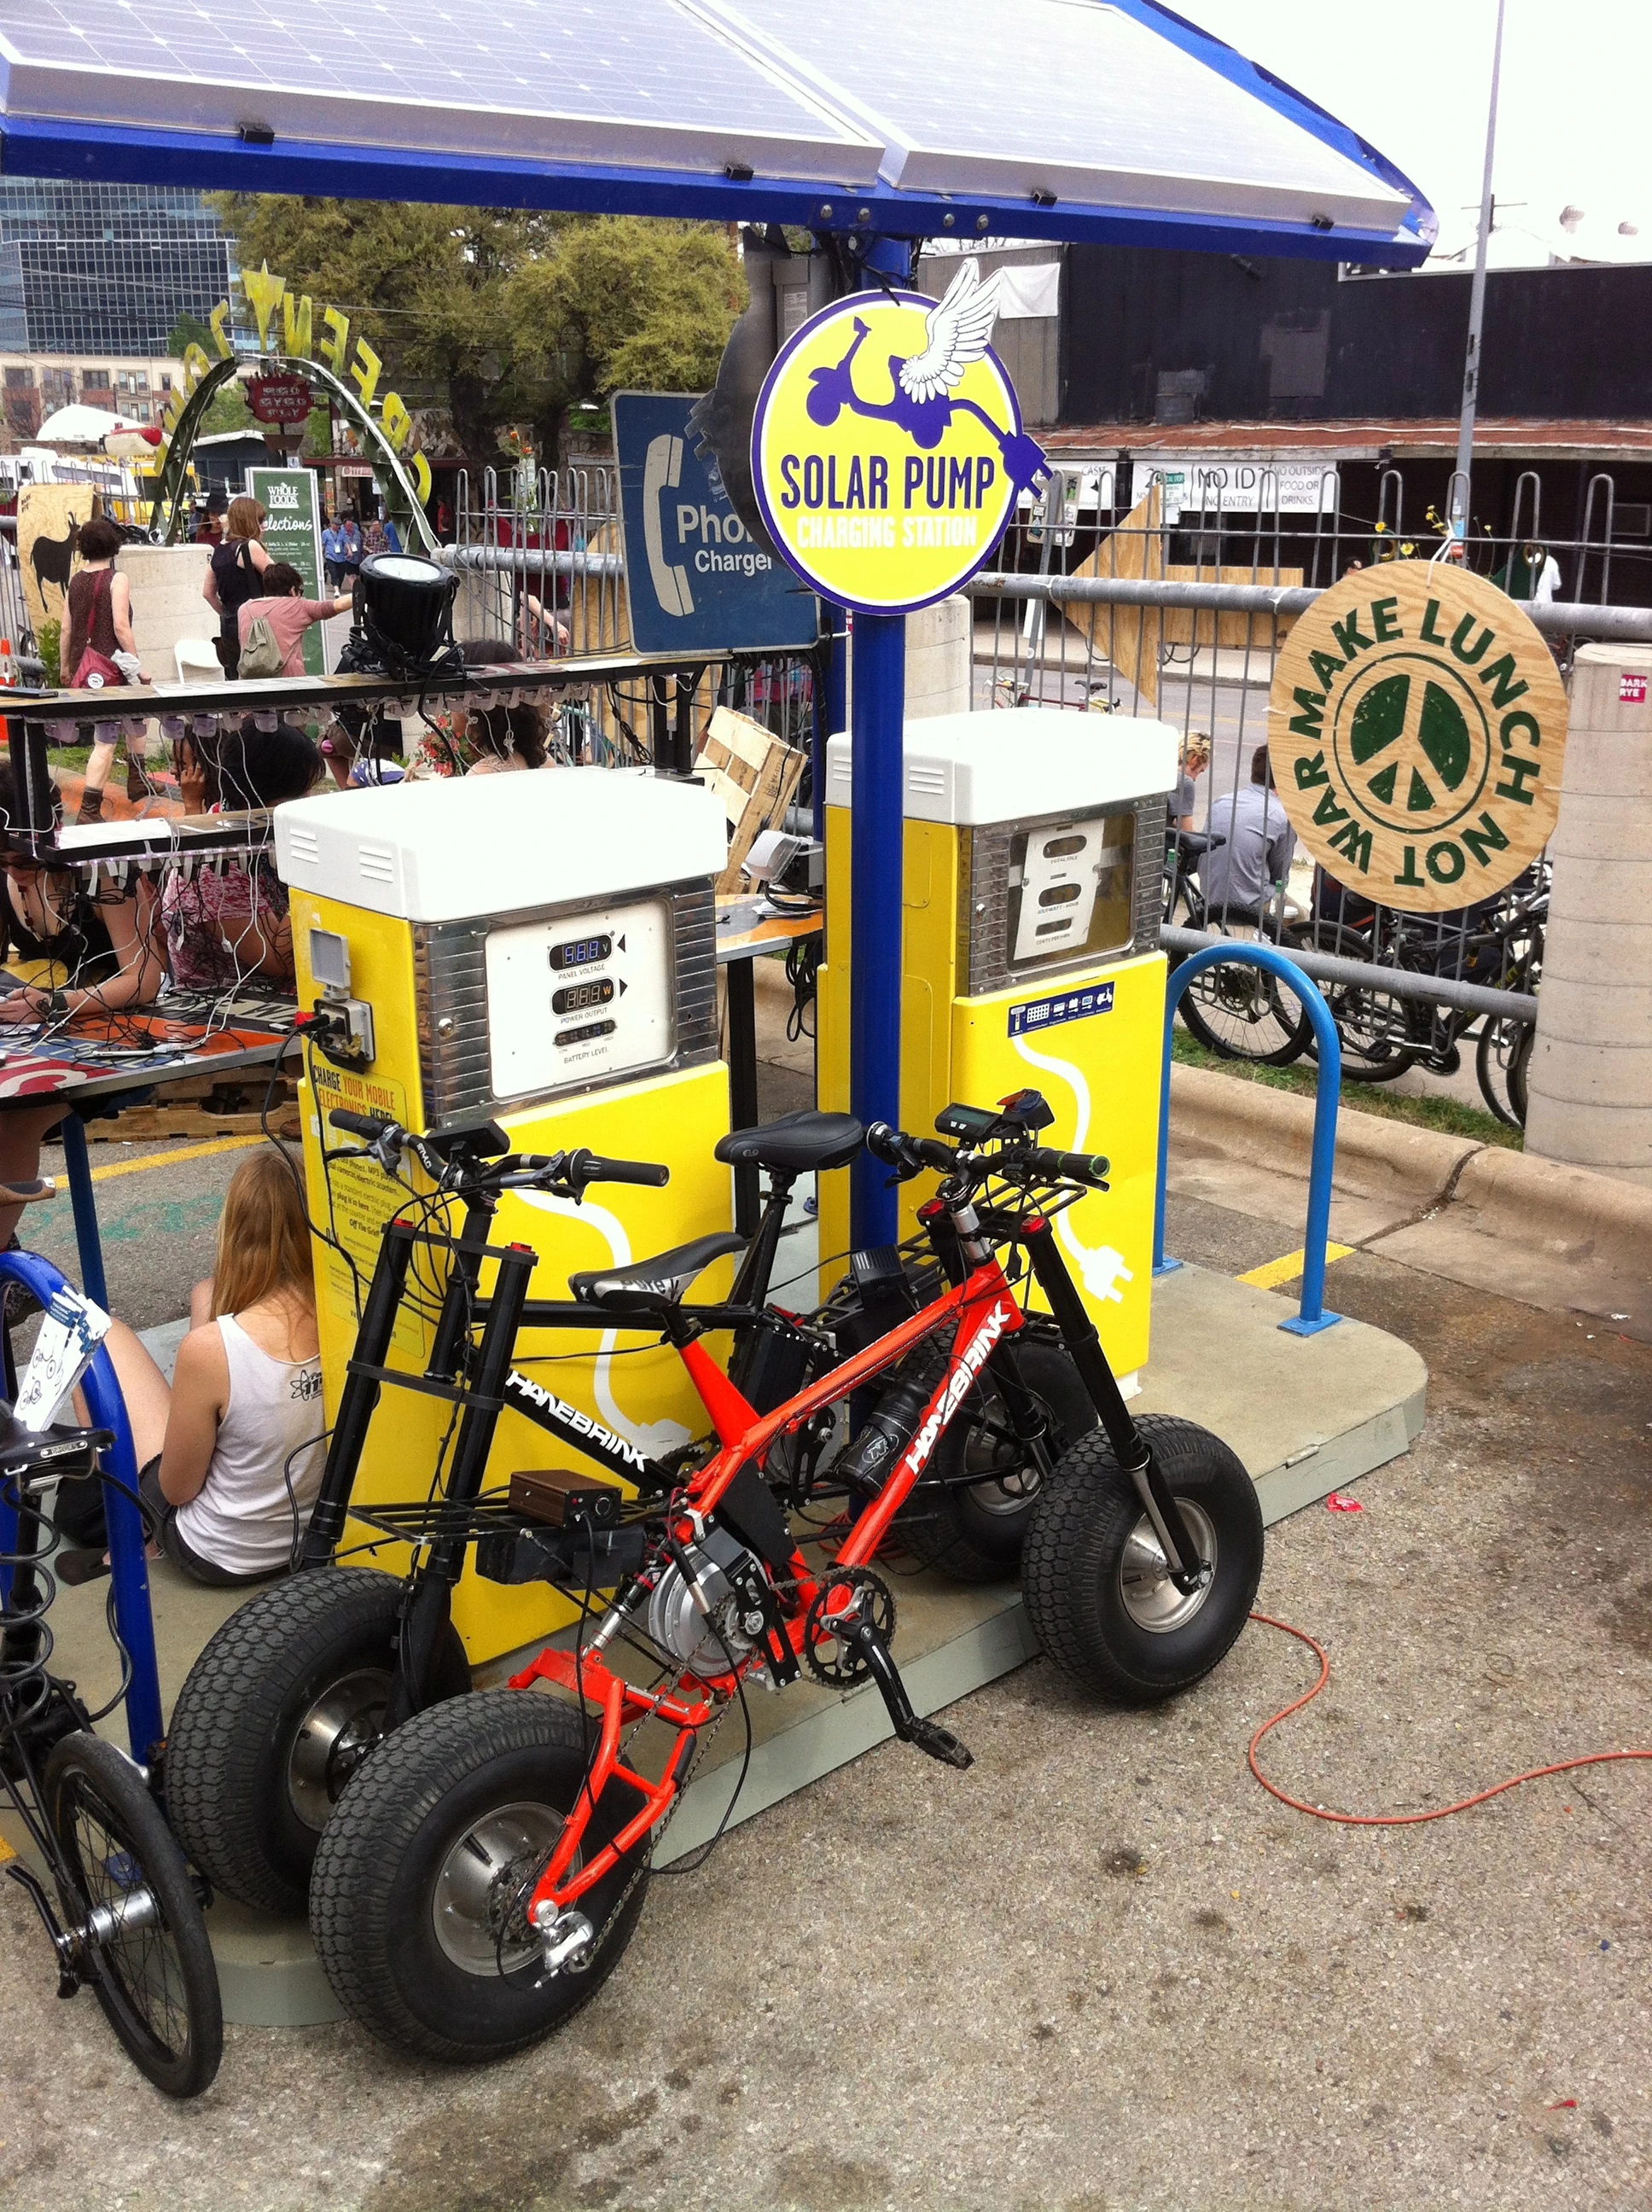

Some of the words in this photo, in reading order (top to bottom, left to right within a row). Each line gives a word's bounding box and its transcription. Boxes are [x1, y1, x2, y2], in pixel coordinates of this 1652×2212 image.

[1197, 468, 1228, 489] NO
[1288, 465, 1328, 476] OUTSIDE
[267, 484, 299, 497] WHOLE
[781, 454, 888, 509] SOLAR
[904, 456, 995, 509] PUMP
[1279, 480, 1305, 491] FOOD
[1306, 480, 1319, 491] OR
[269, 495, 298, 505] FOODS
[1206, 496, 1219, 507] NO
[1223, 496, 1254, 507] ENTRY
[264, 514, 313, 532] elections
[677, 504, 753, 544] Pho
[797, 515, 895, 548] CHARGING
[902, 515, 976, 547] STATION
[1620, 678, 1647, 688] DARK
[1288, 596, 1403, 740] MAKE
[1419, 598, 1541, 806] LUNCH
[1620, 688, 1640, 697] RYE
[1294, 750, 1374, 874] WAR
[1393, 811, 1510, 888] NOT
[602, 942, 608, 952] V
[558, 970, 579, 981] PANEL
[579, 963, 606, 976] VOLTAGE
[602, 985, 612, 997] W
[560, 1012, 584, 1025] POWER
[585, 1007, 608, 1020] OUTPUT
[563, 1051, 590, 1064] BATTERY
[590, 1046, 609, 1057] LEVEL
[313, 1065, 342, 1092] CHARGE
[343, 1076, 364, 1102] YOUR
[366, 1083, 396, 1111] MOBILE
[318, 1089, 368, 1116] ELECTRONICS
[905, 1300, 1011, 1475] HANEBRINK
[506, 1370, 649, 1473] HANEBRINK
